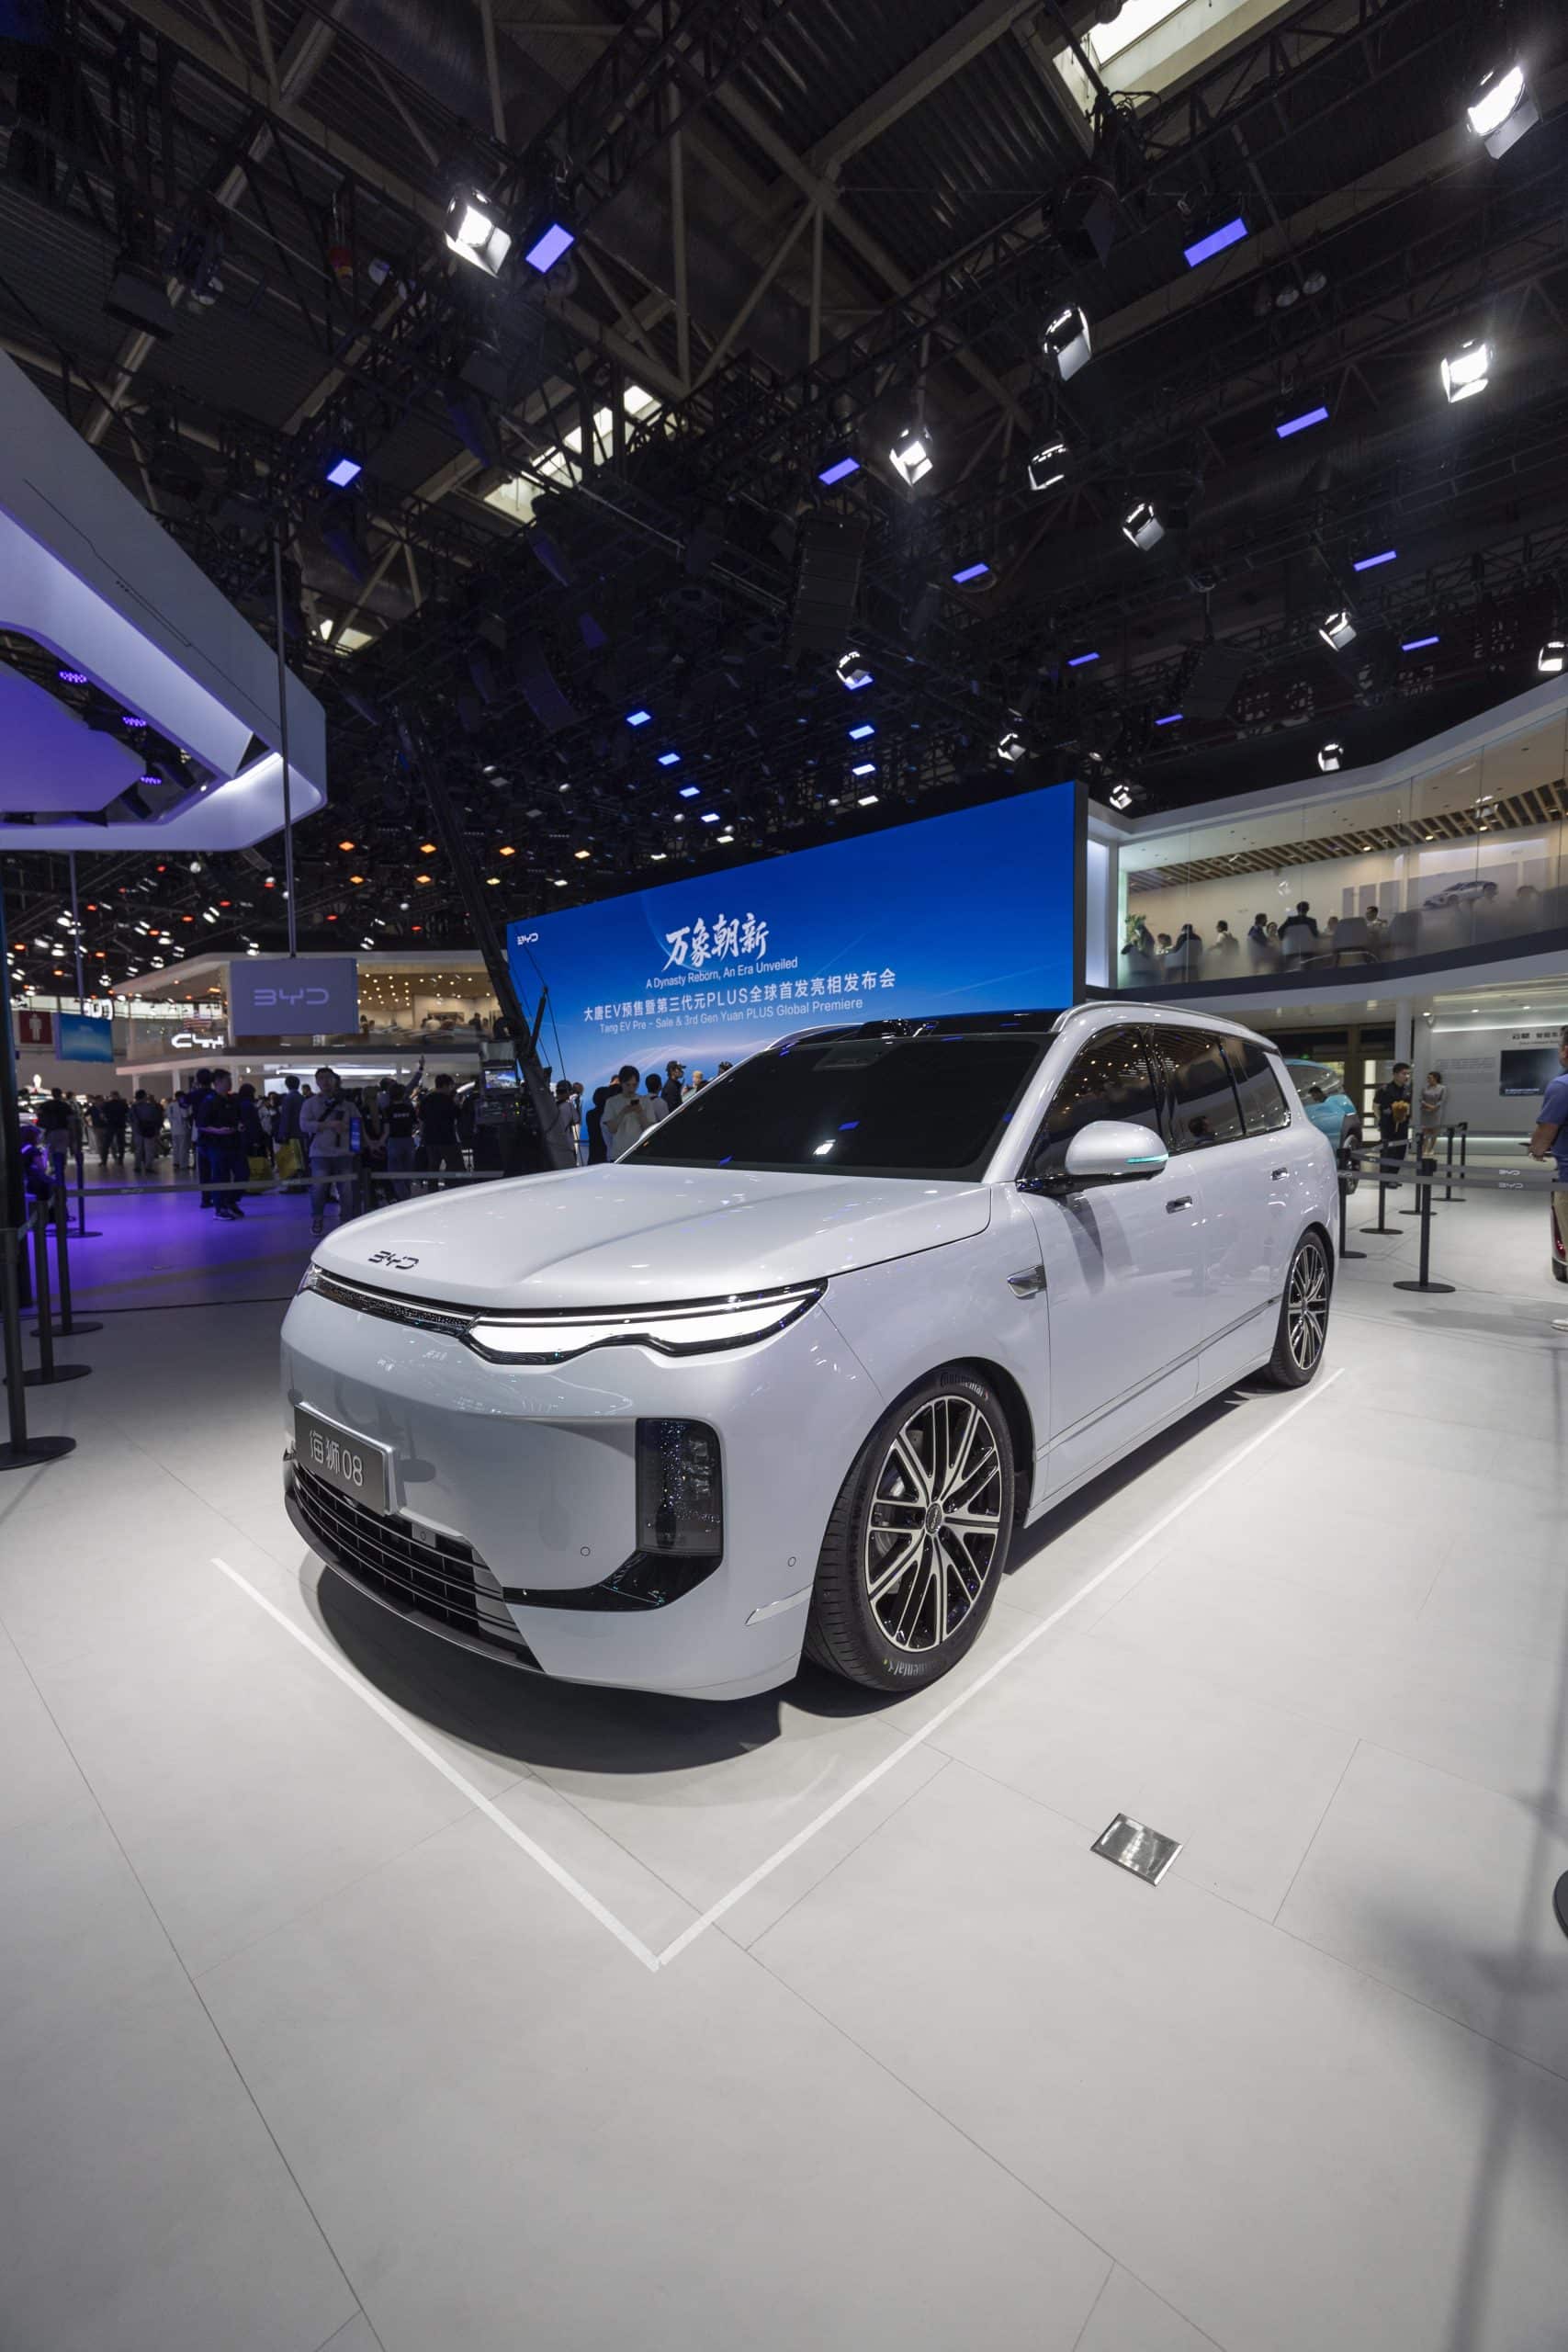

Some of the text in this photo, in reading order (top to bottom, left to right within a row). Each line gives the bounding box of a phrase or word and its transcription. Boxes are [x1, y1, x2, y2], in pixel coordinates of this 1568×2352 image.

[517, 933, 538, 945] BYD
[661, 912, 770, 971] 万象朝新
[646, 956, 798, 989] A Dynasty Reborn, An Era Unveiled
[254, 988, 329, 1006] BYD
[600, 1023, 618, 1035] Tang
[621, 1021, 631, 1031] EV
[633, 1020, 647, 1030] Pre
[655, 1017, 673, 1029] Sale
[675, 1015, 683, 1025] &
[684, 1013, 698, 1025] 3rd
[700, 1013, 718, 1023] Gen
[721, 1010, 744, 1022] Yuan
[746, 1006, 773, 1020] PLUS
[775, 1001, 809, 1016] Global
[812, 998, 863, 1012] Premiere
[1498, 1182, 1523, 1190] BYD
[367, 1250, 419, 1270] BYD
[310, 1430, 364, 1487] 海狮08
